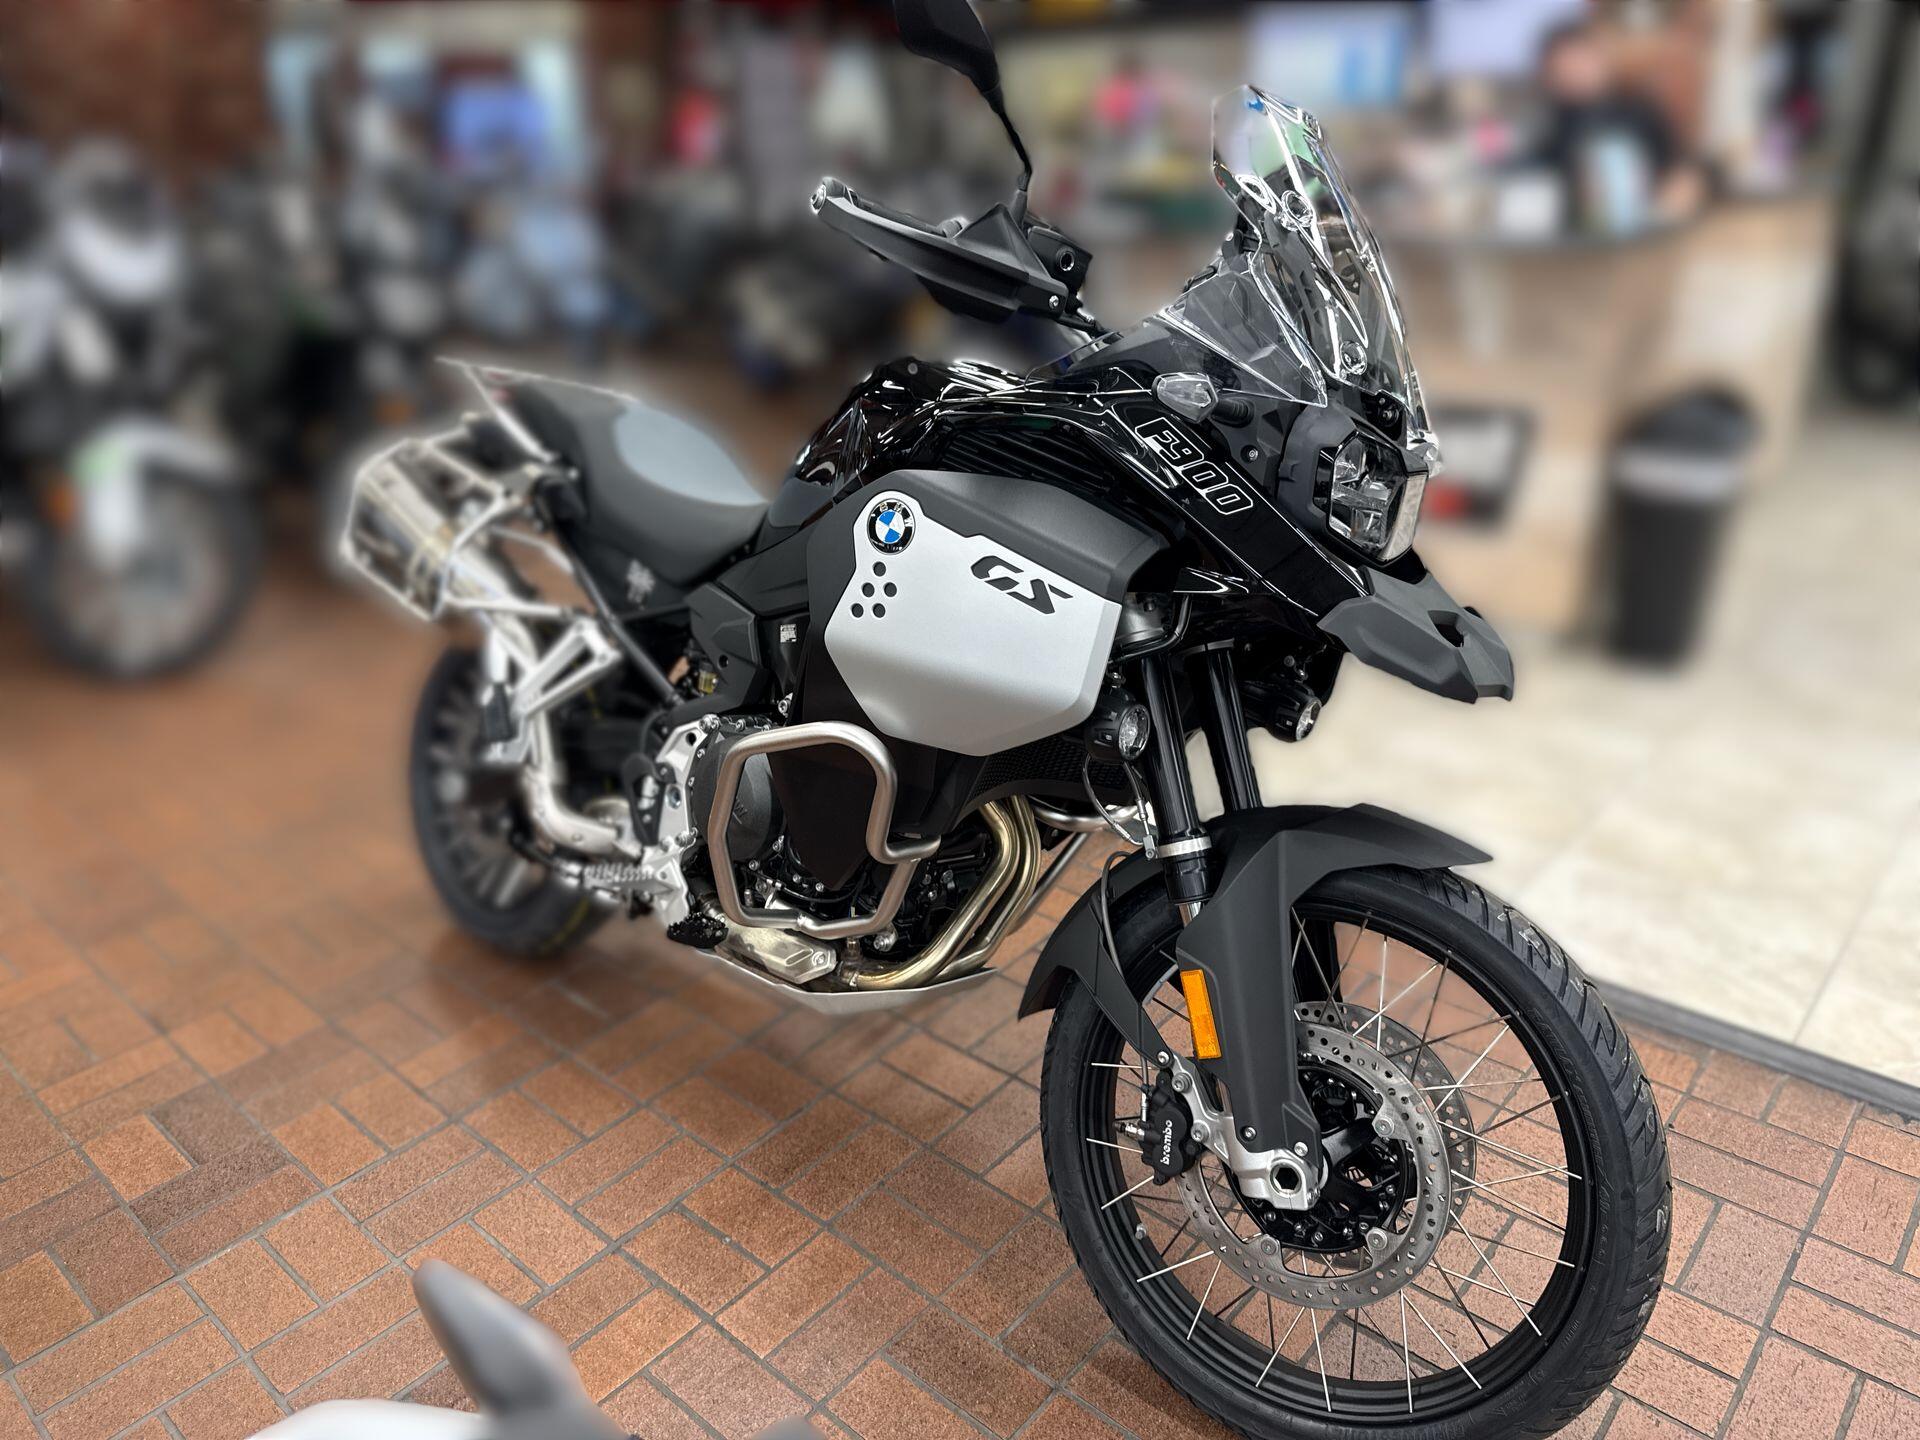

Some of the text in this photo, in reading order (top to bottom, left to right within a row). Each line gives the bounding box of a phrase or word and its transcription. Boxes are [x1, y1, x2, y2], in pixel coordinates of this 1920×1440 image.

[1135, 417, 1253, 515] F900
[970, 555, 1074, 615] GS
[1160, 1119, 1173, 1166] brembo
